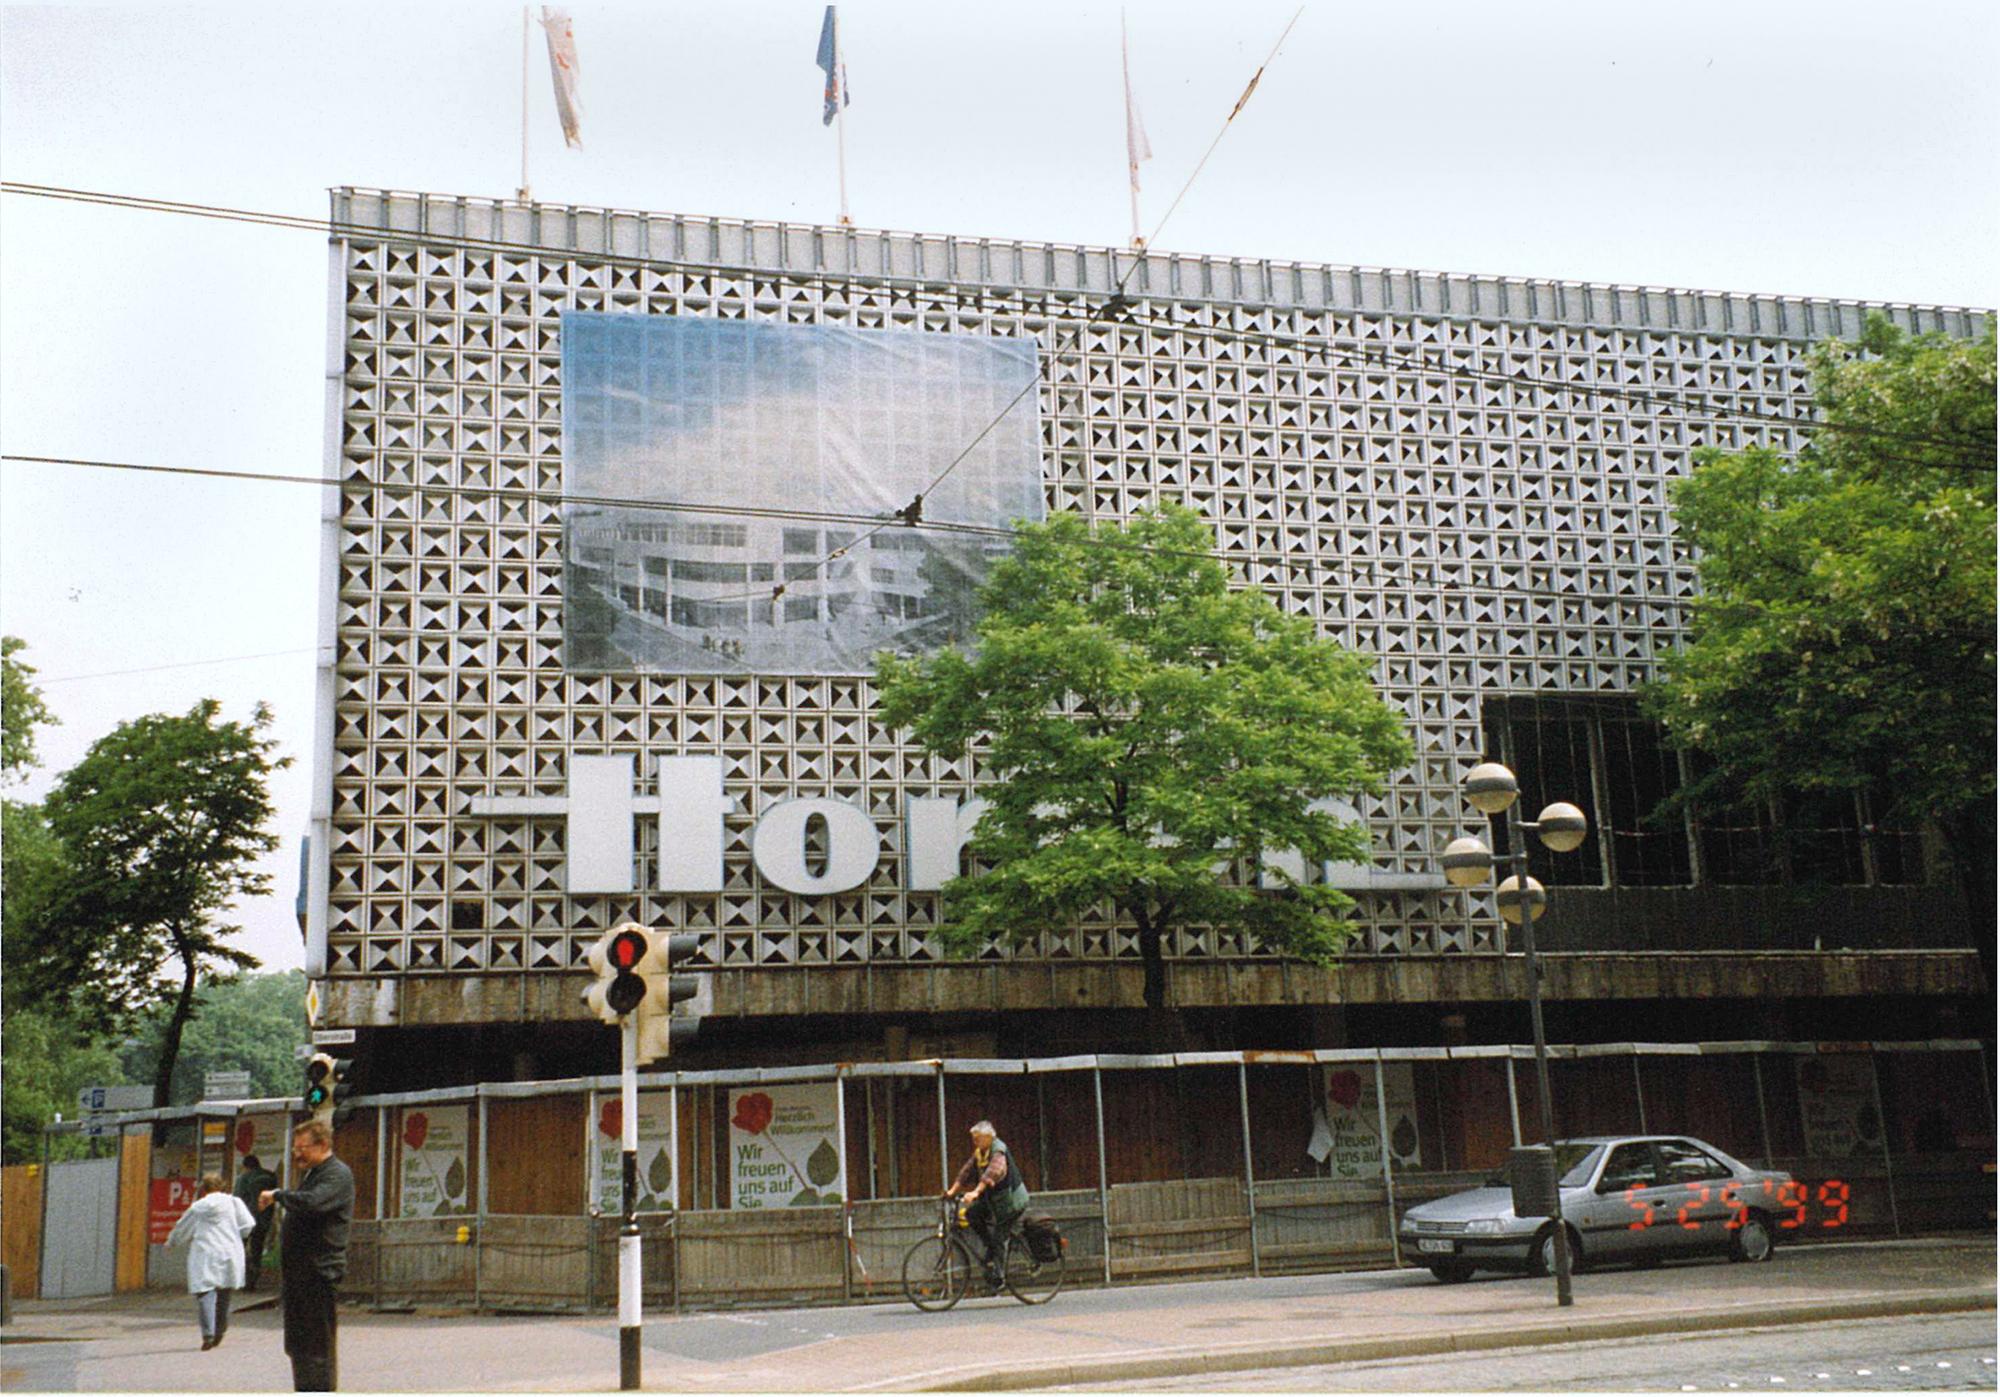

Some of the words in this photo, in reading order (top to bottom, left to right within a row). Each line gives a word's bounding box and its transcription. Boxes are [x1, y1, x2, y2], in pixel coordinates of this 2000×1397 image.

[737, 1143, 763, 1160] Wir
[1336, 1151, 1361, 1164] uns
[737, 1160, 787, 1178] freuen
[738, 1182, 766, 1196] uns
[769, 1175, 796, 1194] auf
[737, 1196, 763, 1208] Sie
